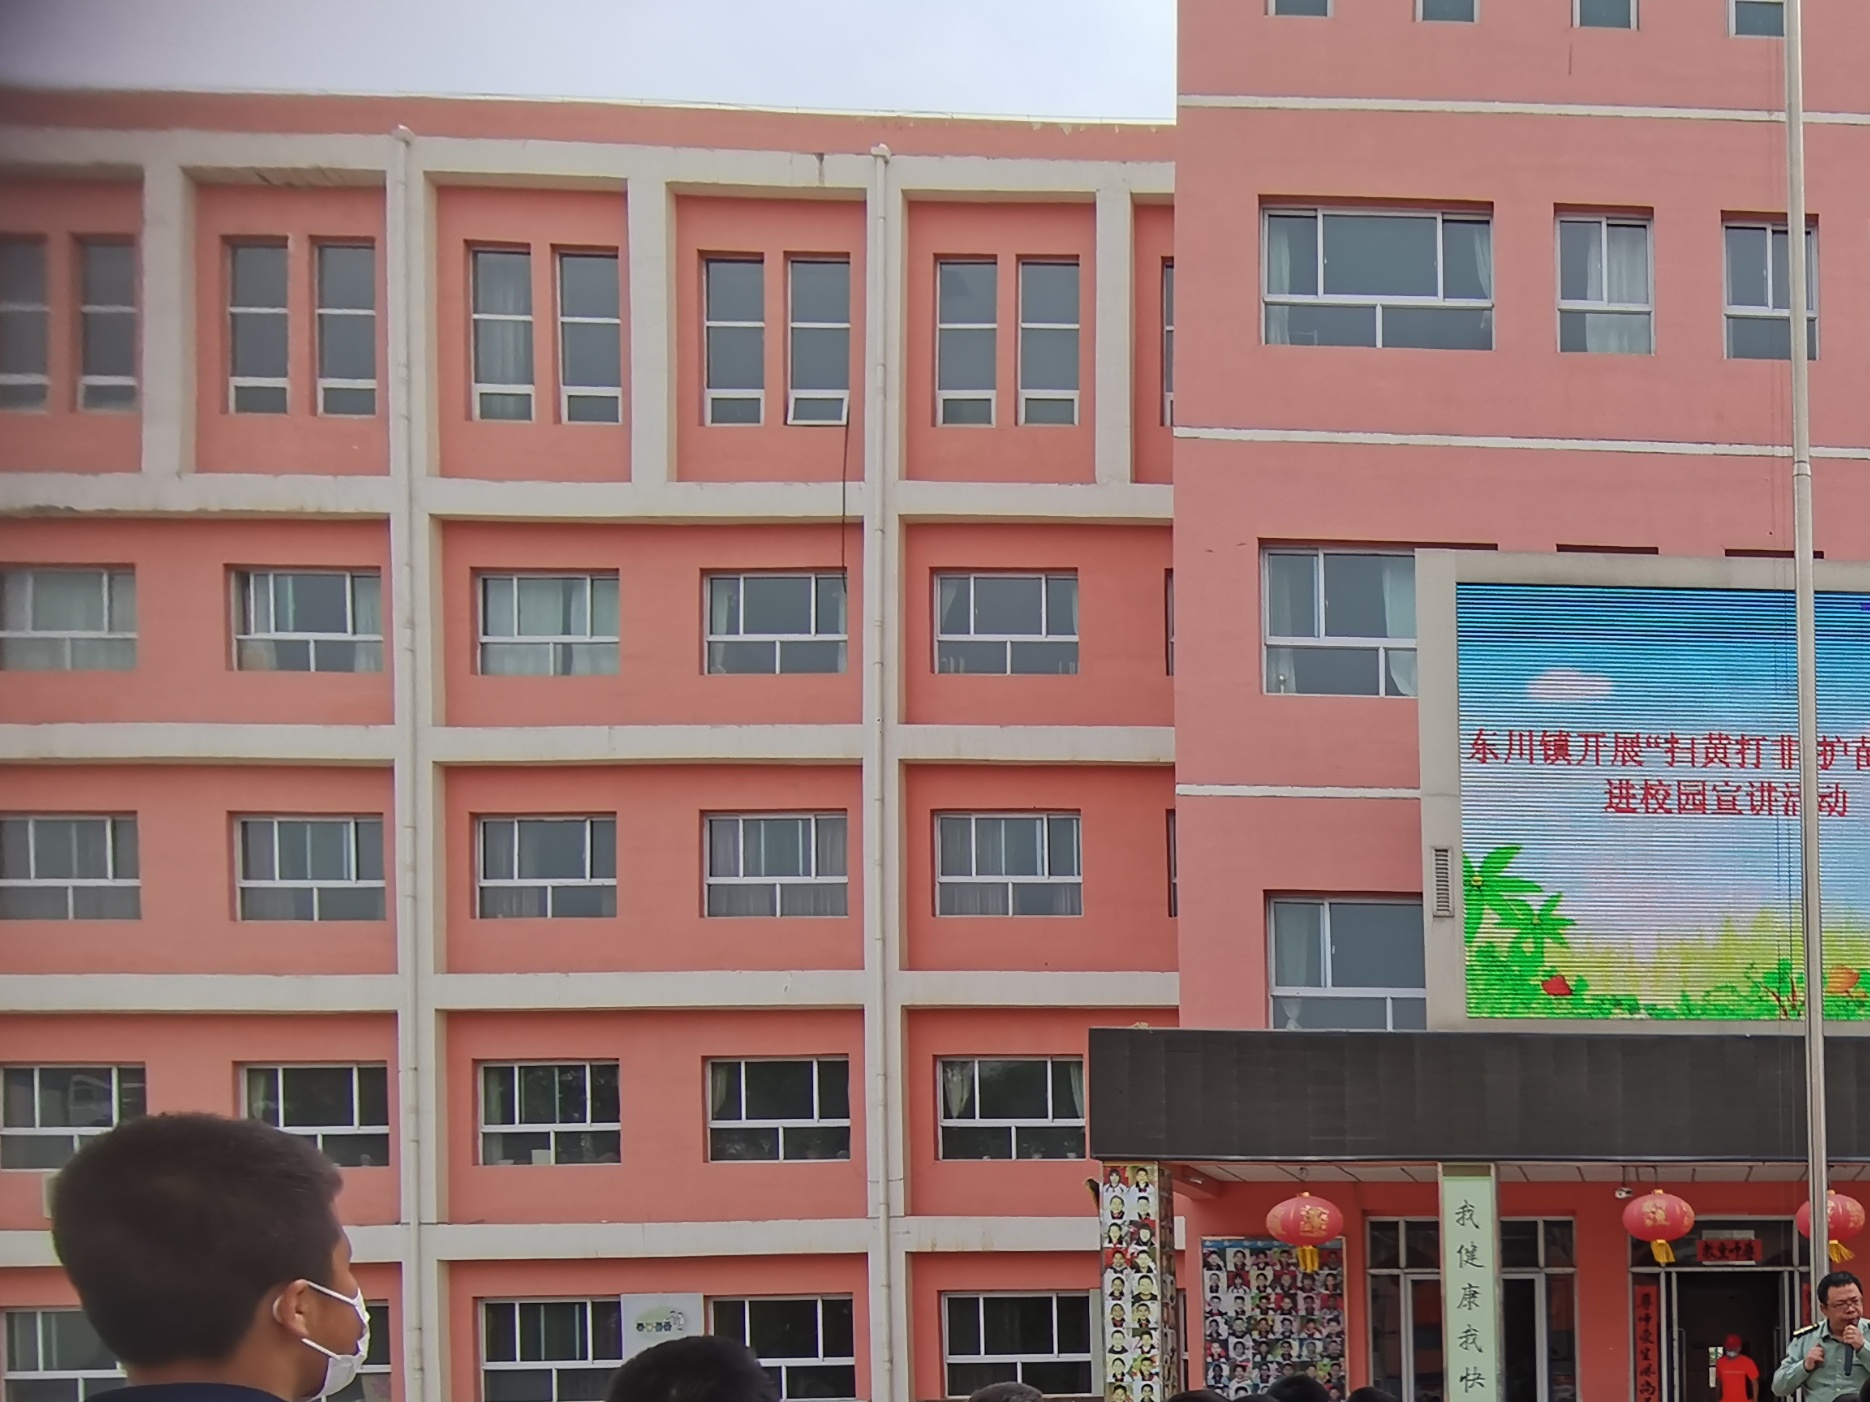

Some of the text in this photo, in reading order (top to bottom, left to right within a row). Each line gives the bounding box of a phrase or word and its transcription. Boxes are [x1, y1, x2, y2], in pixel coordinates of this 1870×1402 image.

[1604, 778, 1848, 817] 进校园宣讲活动
